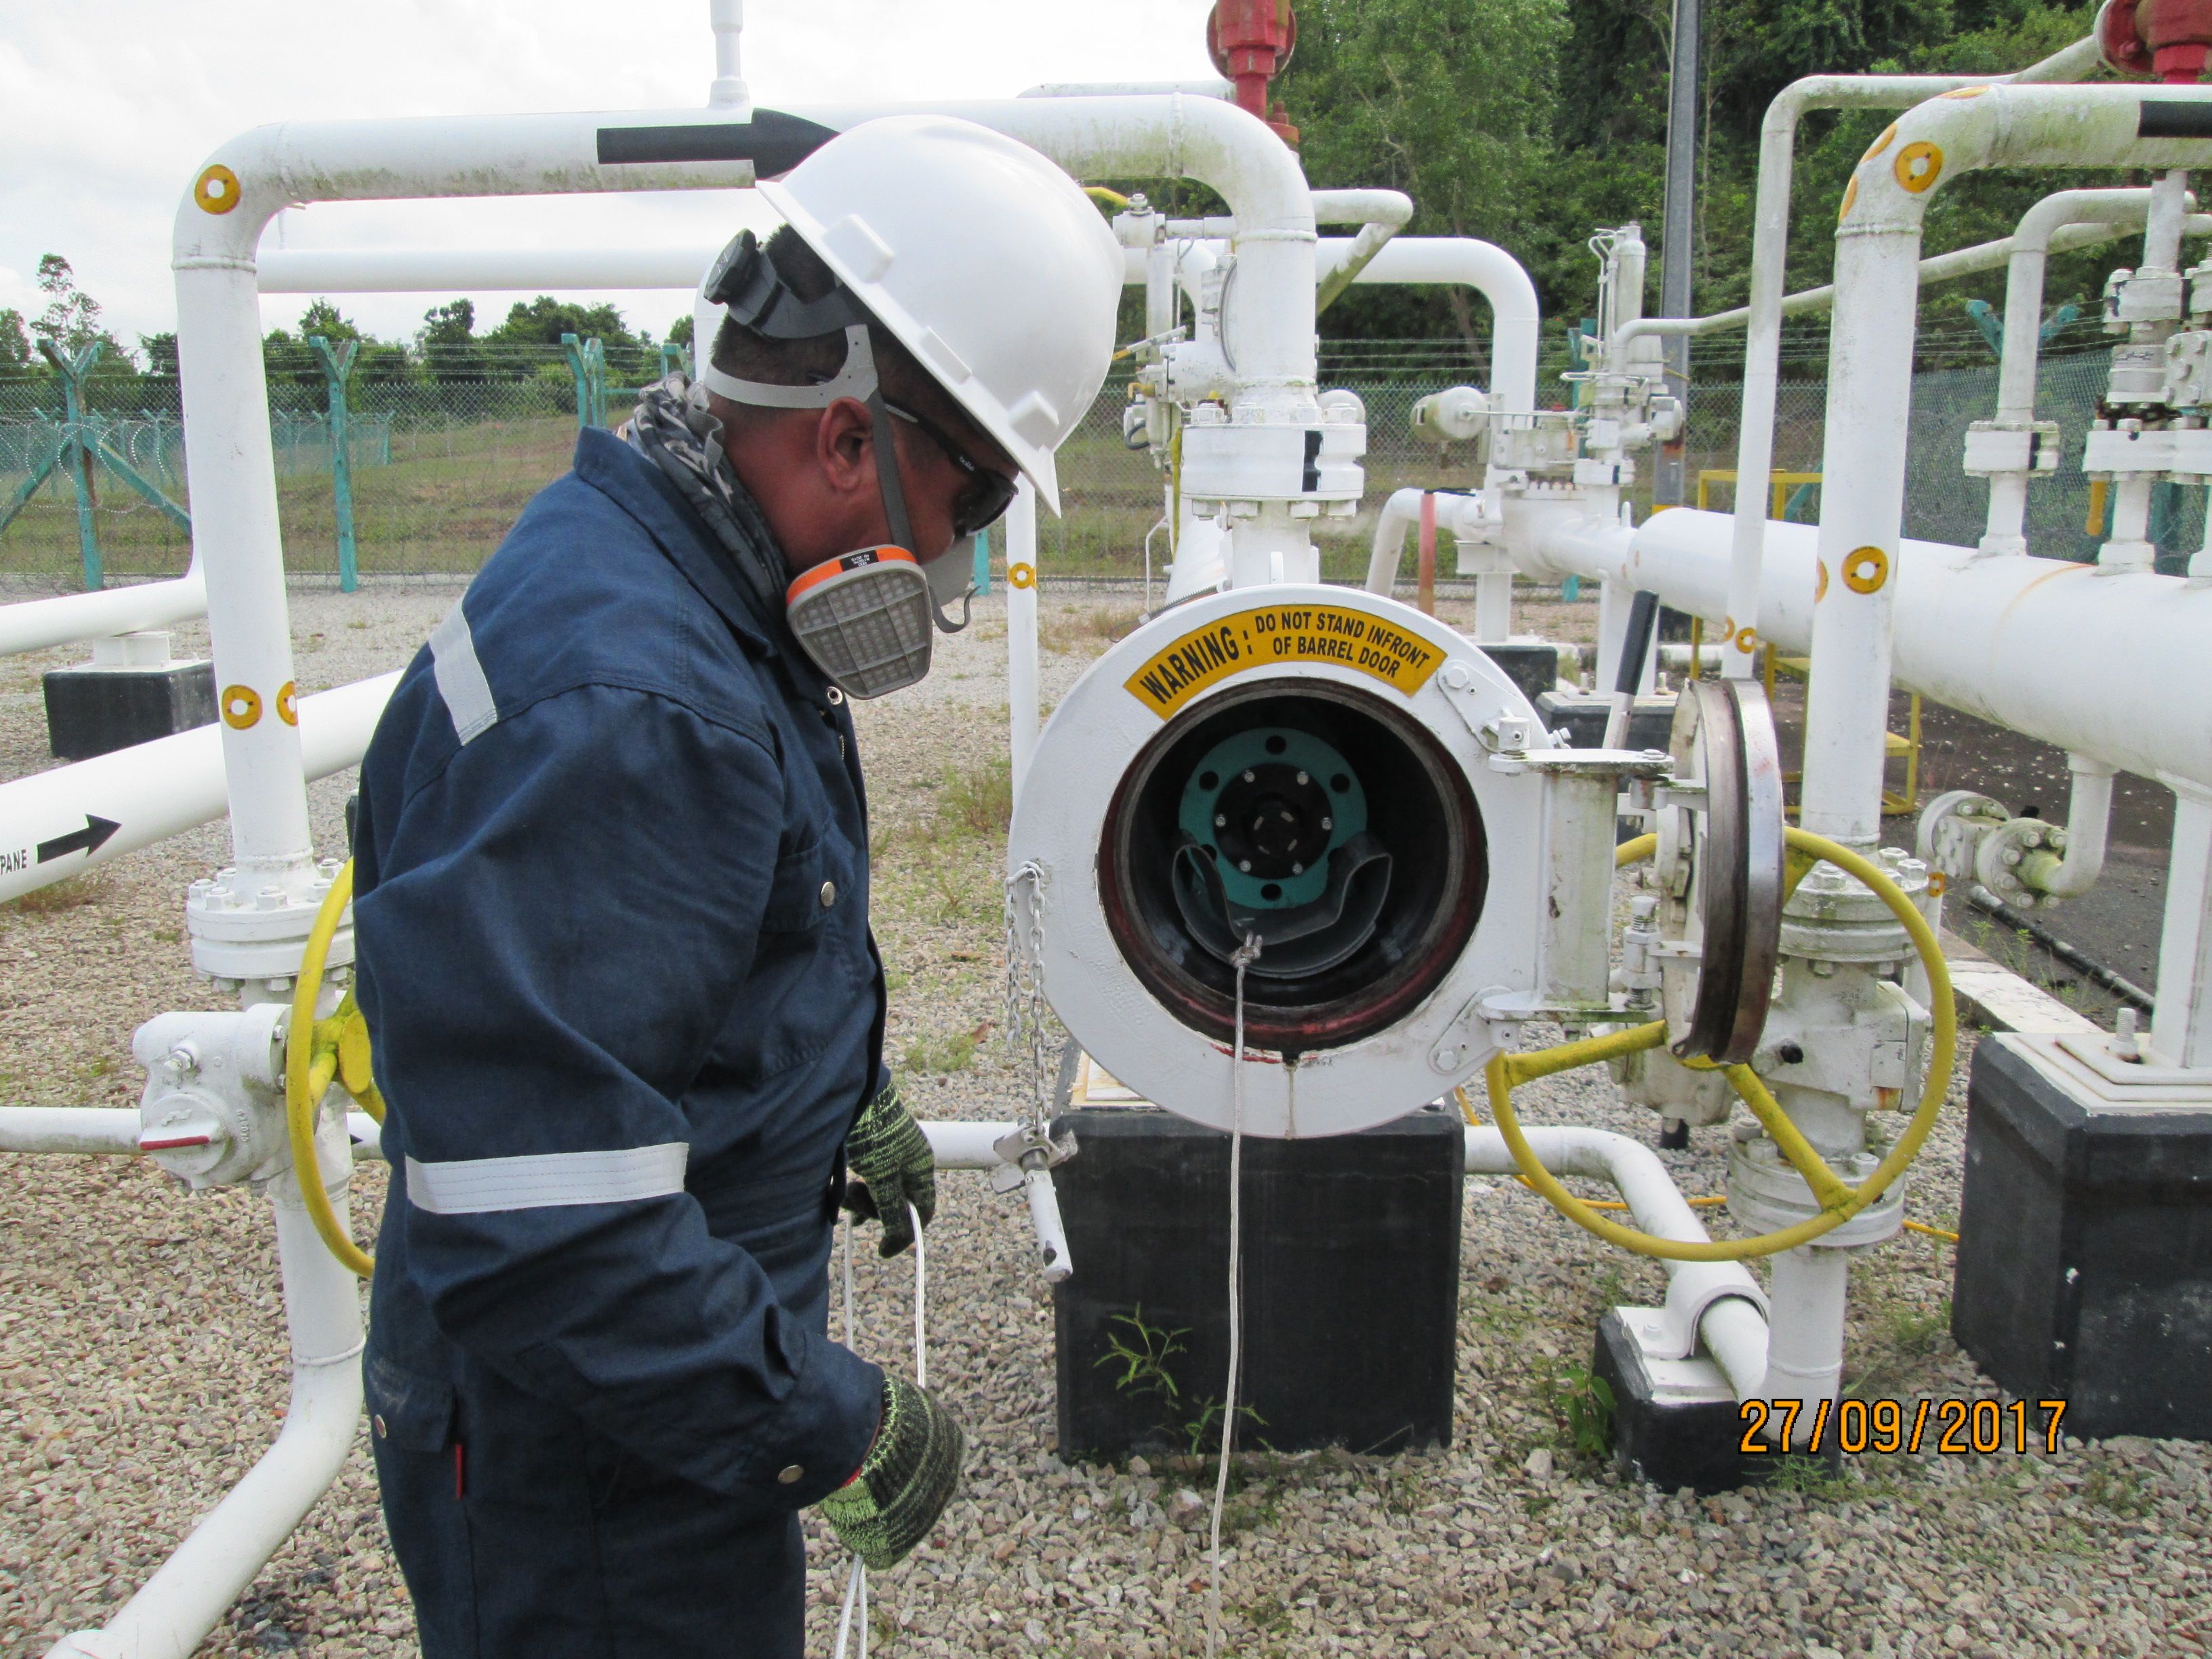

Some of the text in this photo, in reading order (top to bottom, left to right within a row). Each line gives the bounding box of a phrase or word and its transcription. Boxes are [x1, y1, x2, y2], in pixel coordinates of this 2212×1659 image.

[1255, 611, 1430, 669] DO NOT STAND INFRONT
[1273, 636, 1401, 678] OF BARREL DOOR
[1139, 626, 1239, 705] WARNING
[0, 848, 27, 876] PANE
